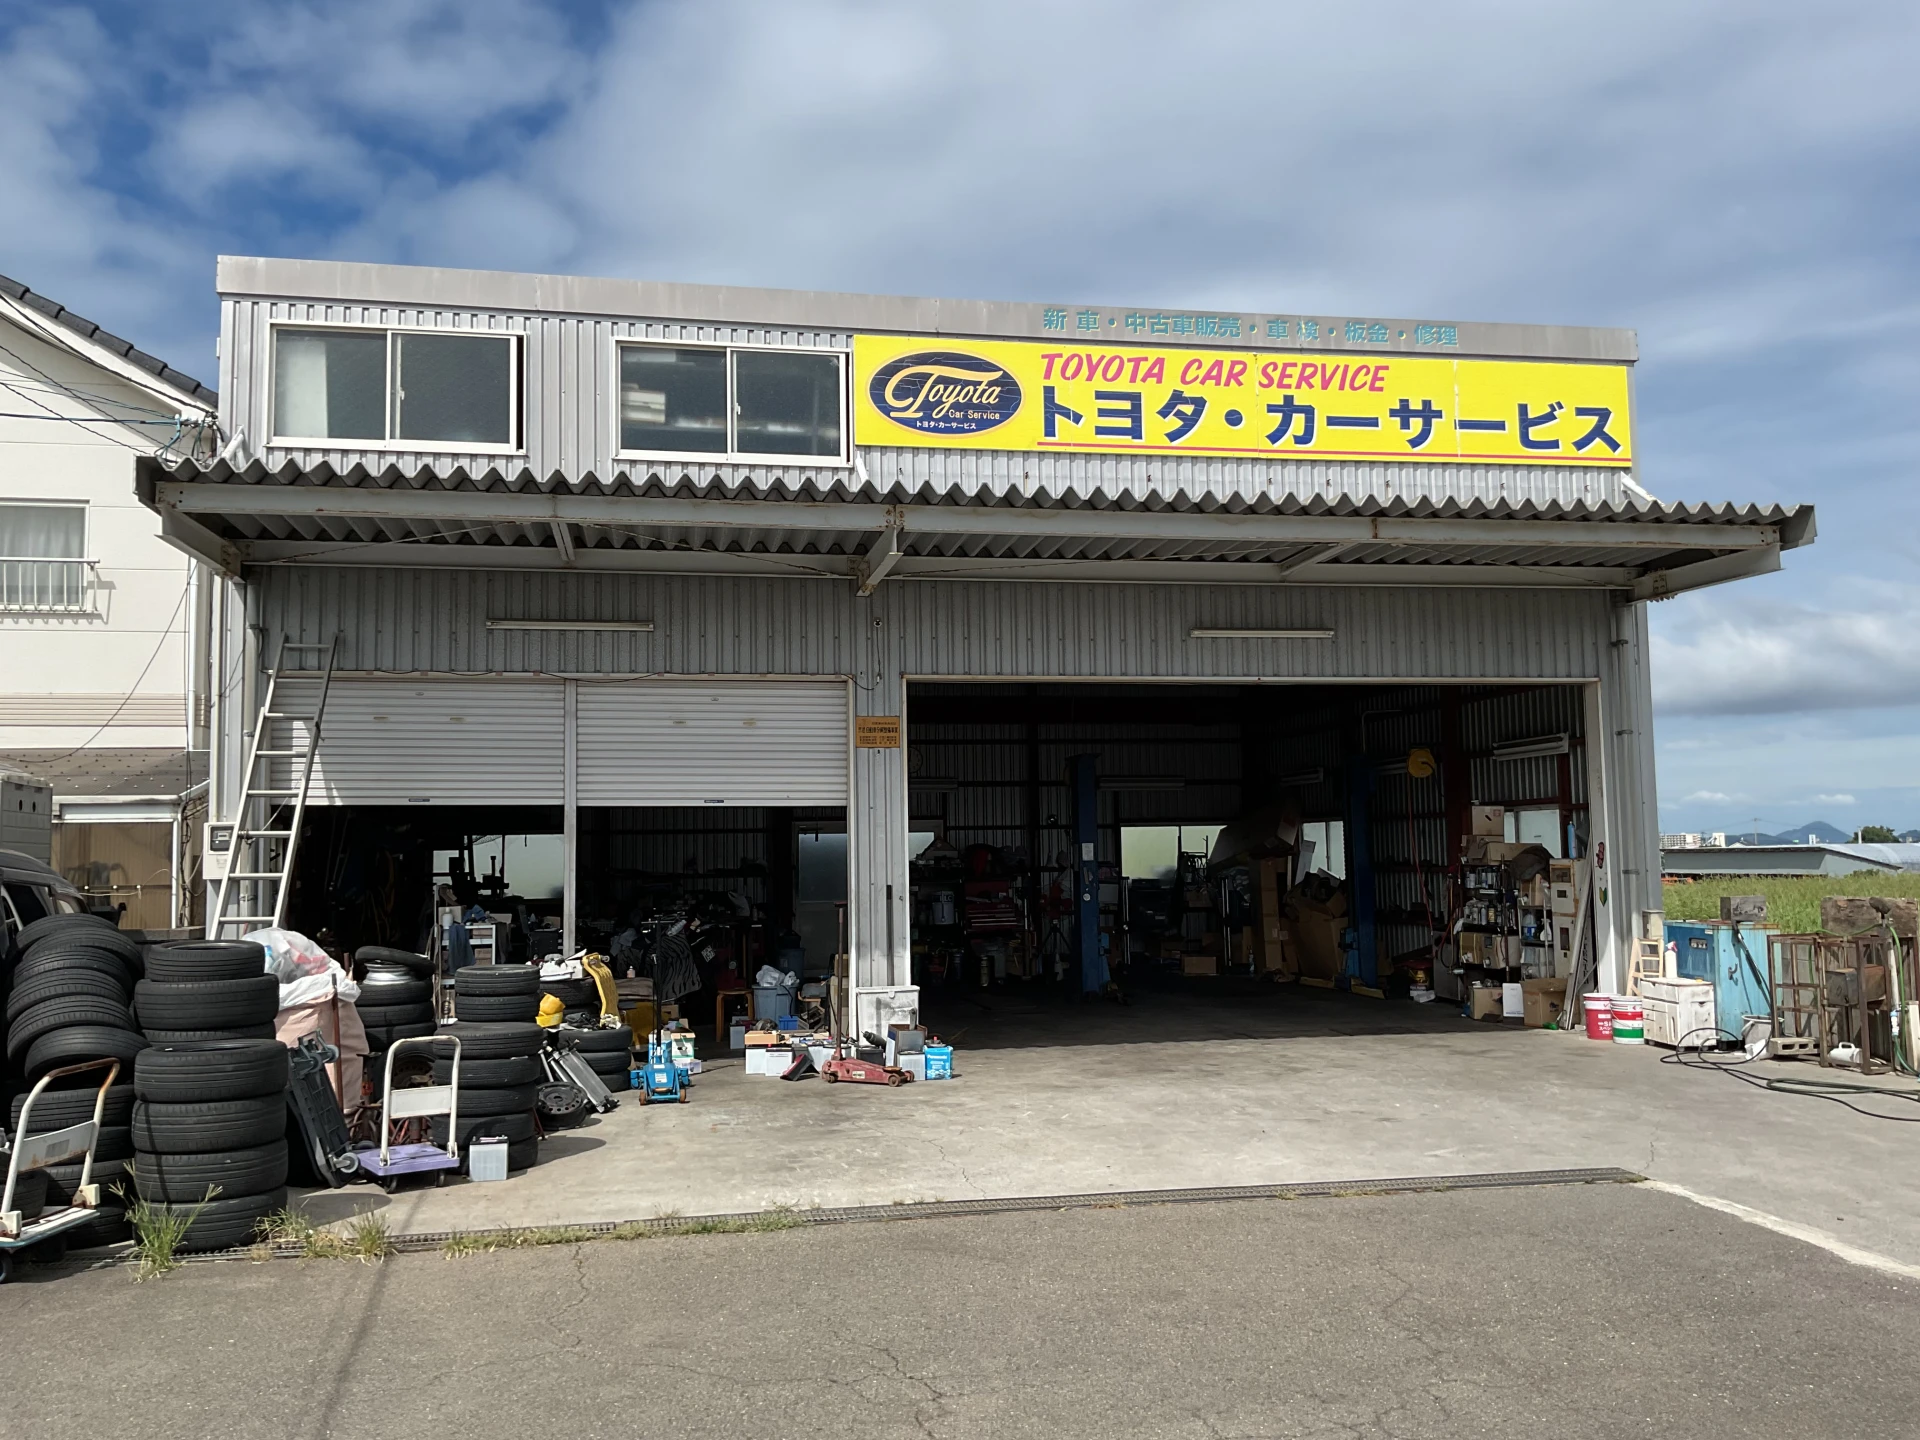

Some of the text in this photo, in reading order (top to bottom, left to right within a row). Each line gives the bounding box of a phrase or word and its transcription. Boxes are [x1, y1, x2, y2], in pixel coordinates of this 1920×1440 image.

[885, 365, 1003, 418] Toyota
[1042, 353, 1388, 392] TOYOTA CAR SERVICE
[948, 409, 1000, 419] Car Service
[1043, 385, 1622, 454] トヨタ・カーサービス
